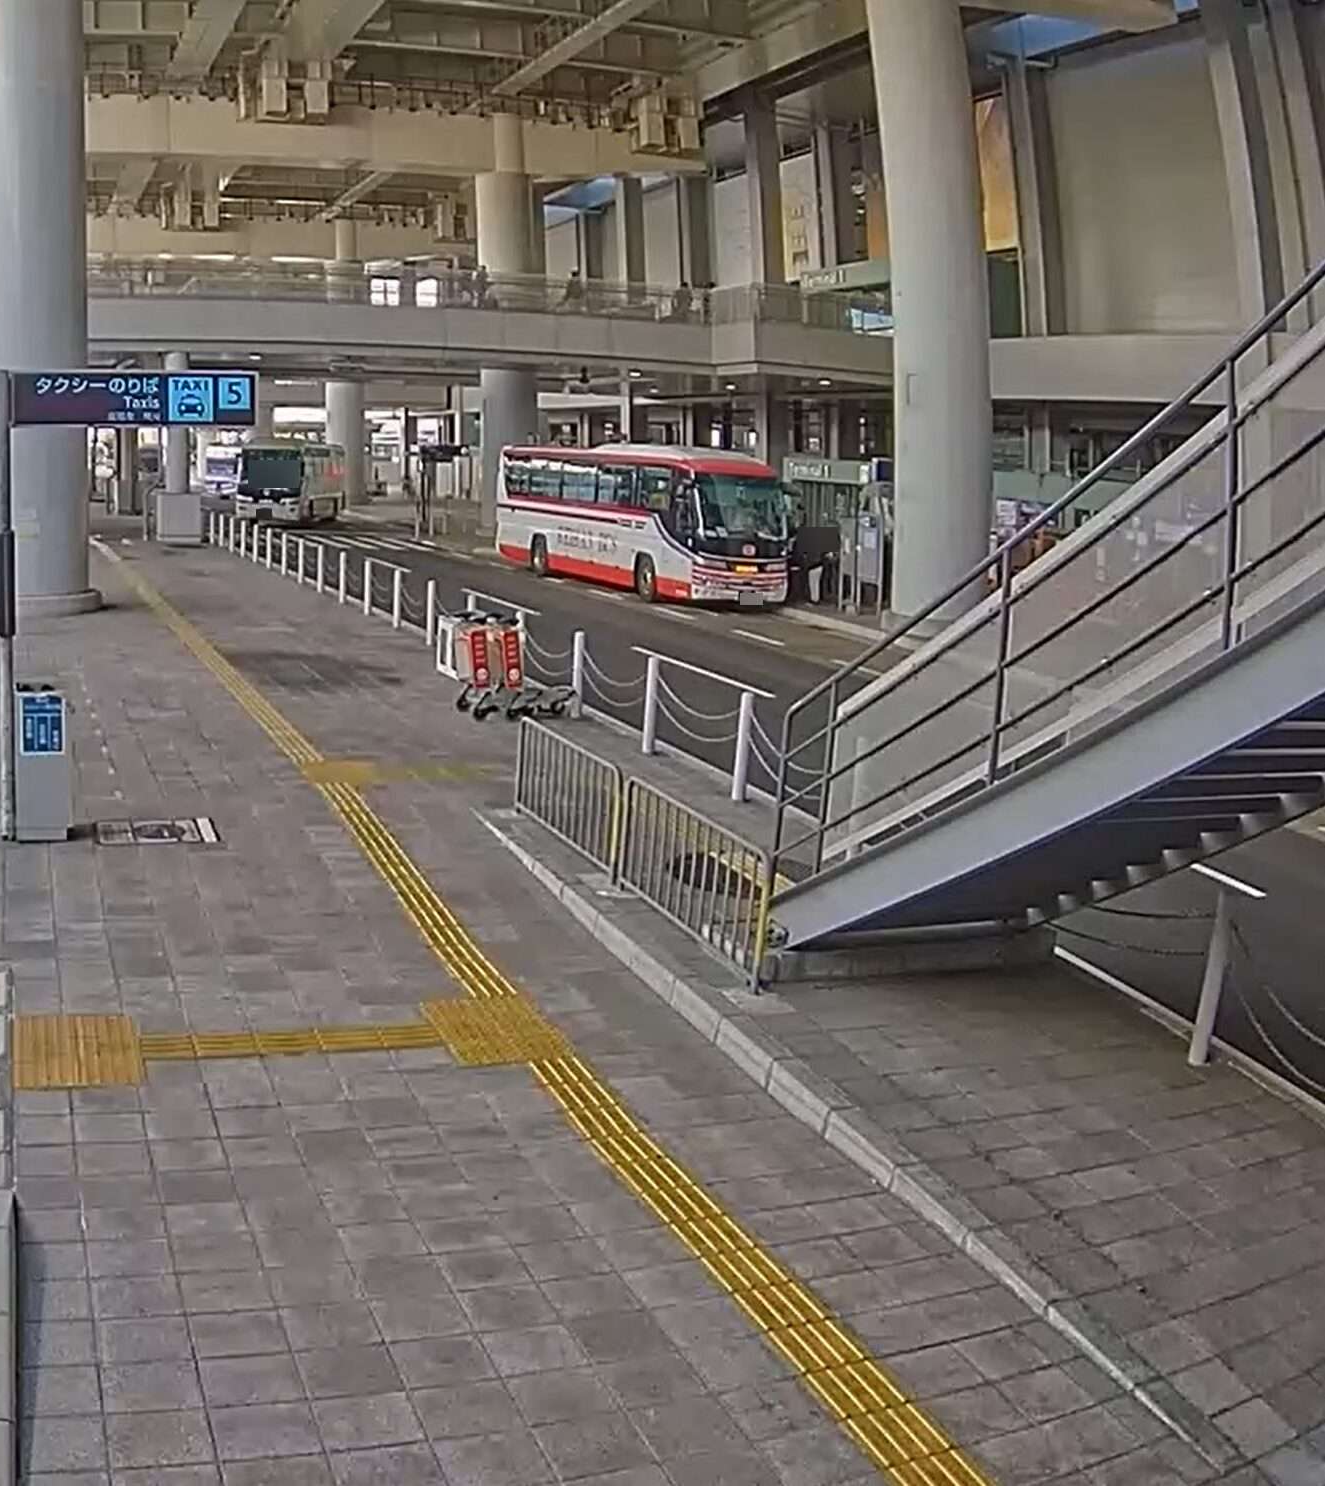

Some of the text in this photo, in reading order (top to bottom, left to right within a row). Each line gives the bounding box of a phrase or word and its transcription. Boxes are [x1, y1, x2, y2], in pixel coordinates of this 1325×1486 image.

[36, 377, 159, 394] タクシーのりば
[172, 379, 209, 391] TAXI
[227, 381, 242, 405] 5
[123, 396, 160, 409] Taxis
